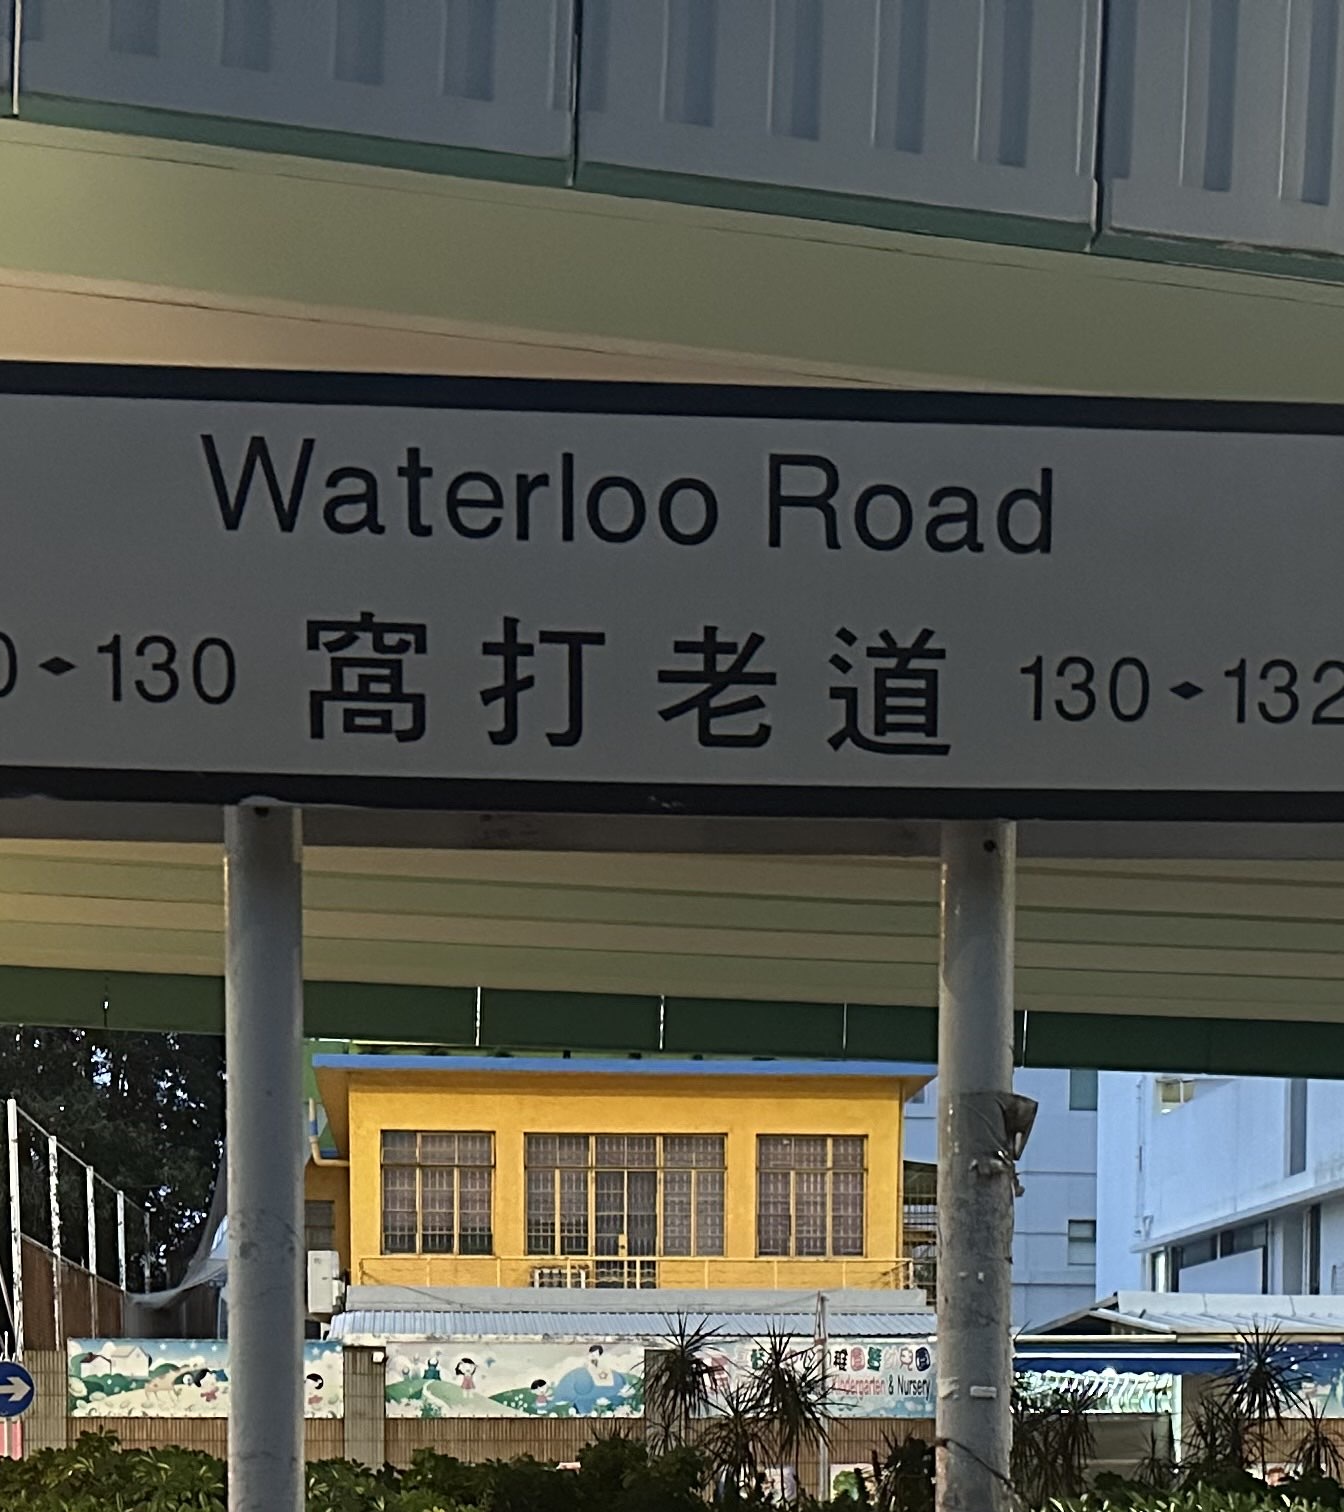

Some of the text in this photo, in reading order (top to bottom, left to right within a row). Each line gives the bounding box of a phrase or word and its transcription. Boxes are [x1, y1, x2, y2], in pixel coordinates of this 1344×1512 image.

[200, 434, 1053, 554] Waterloo Road
[97, 634, 236, 705] 130
[306, 612, 951, 756] 窩打老道
[1020, 655, 1150, 723] 130
[832, 1375, 931, 1401] Kindergarten & Nursery
